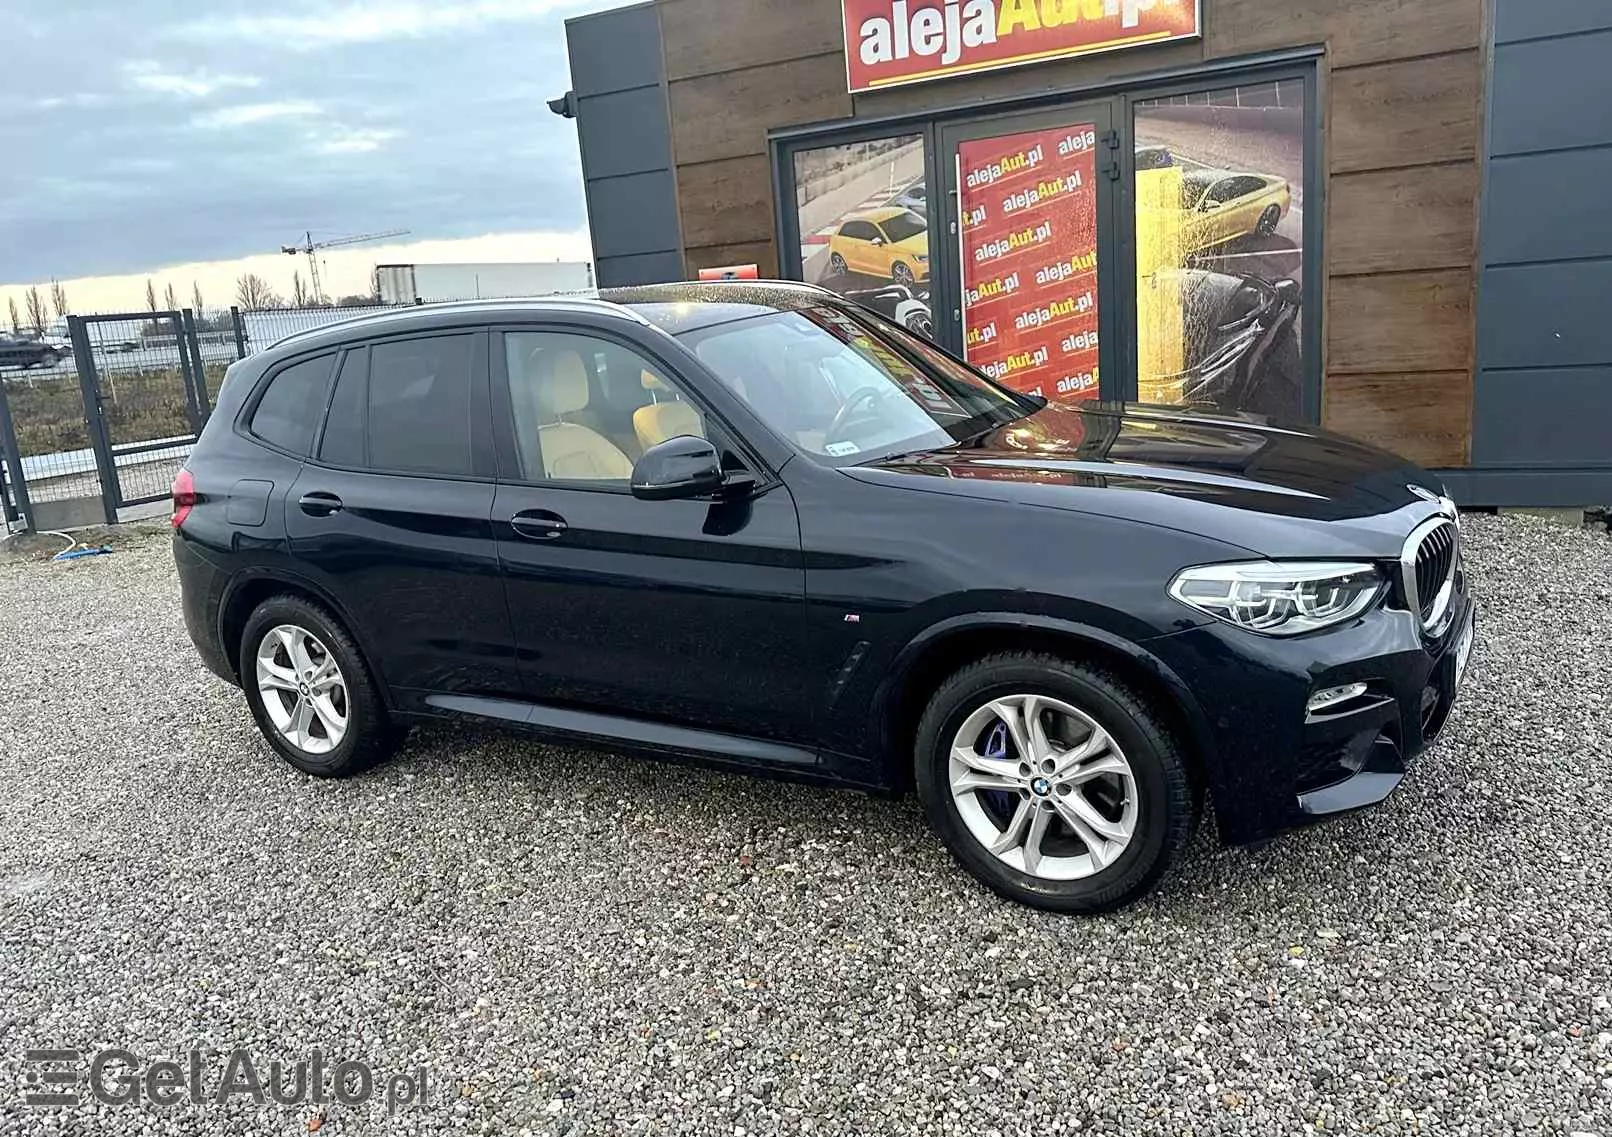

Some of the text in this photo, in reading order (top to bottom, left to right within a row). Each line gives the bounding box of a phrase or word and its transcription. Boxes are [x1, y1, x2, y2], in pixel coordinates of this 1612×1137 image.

[966, 144, 1044, 188] alejaAut.pl
[1002, 170, 1083, 213] alejaAut.pl
[975, 222, 1052, 261] alejaAut.pl
[1015, 292, 1093, 329] alejaAut.pl
